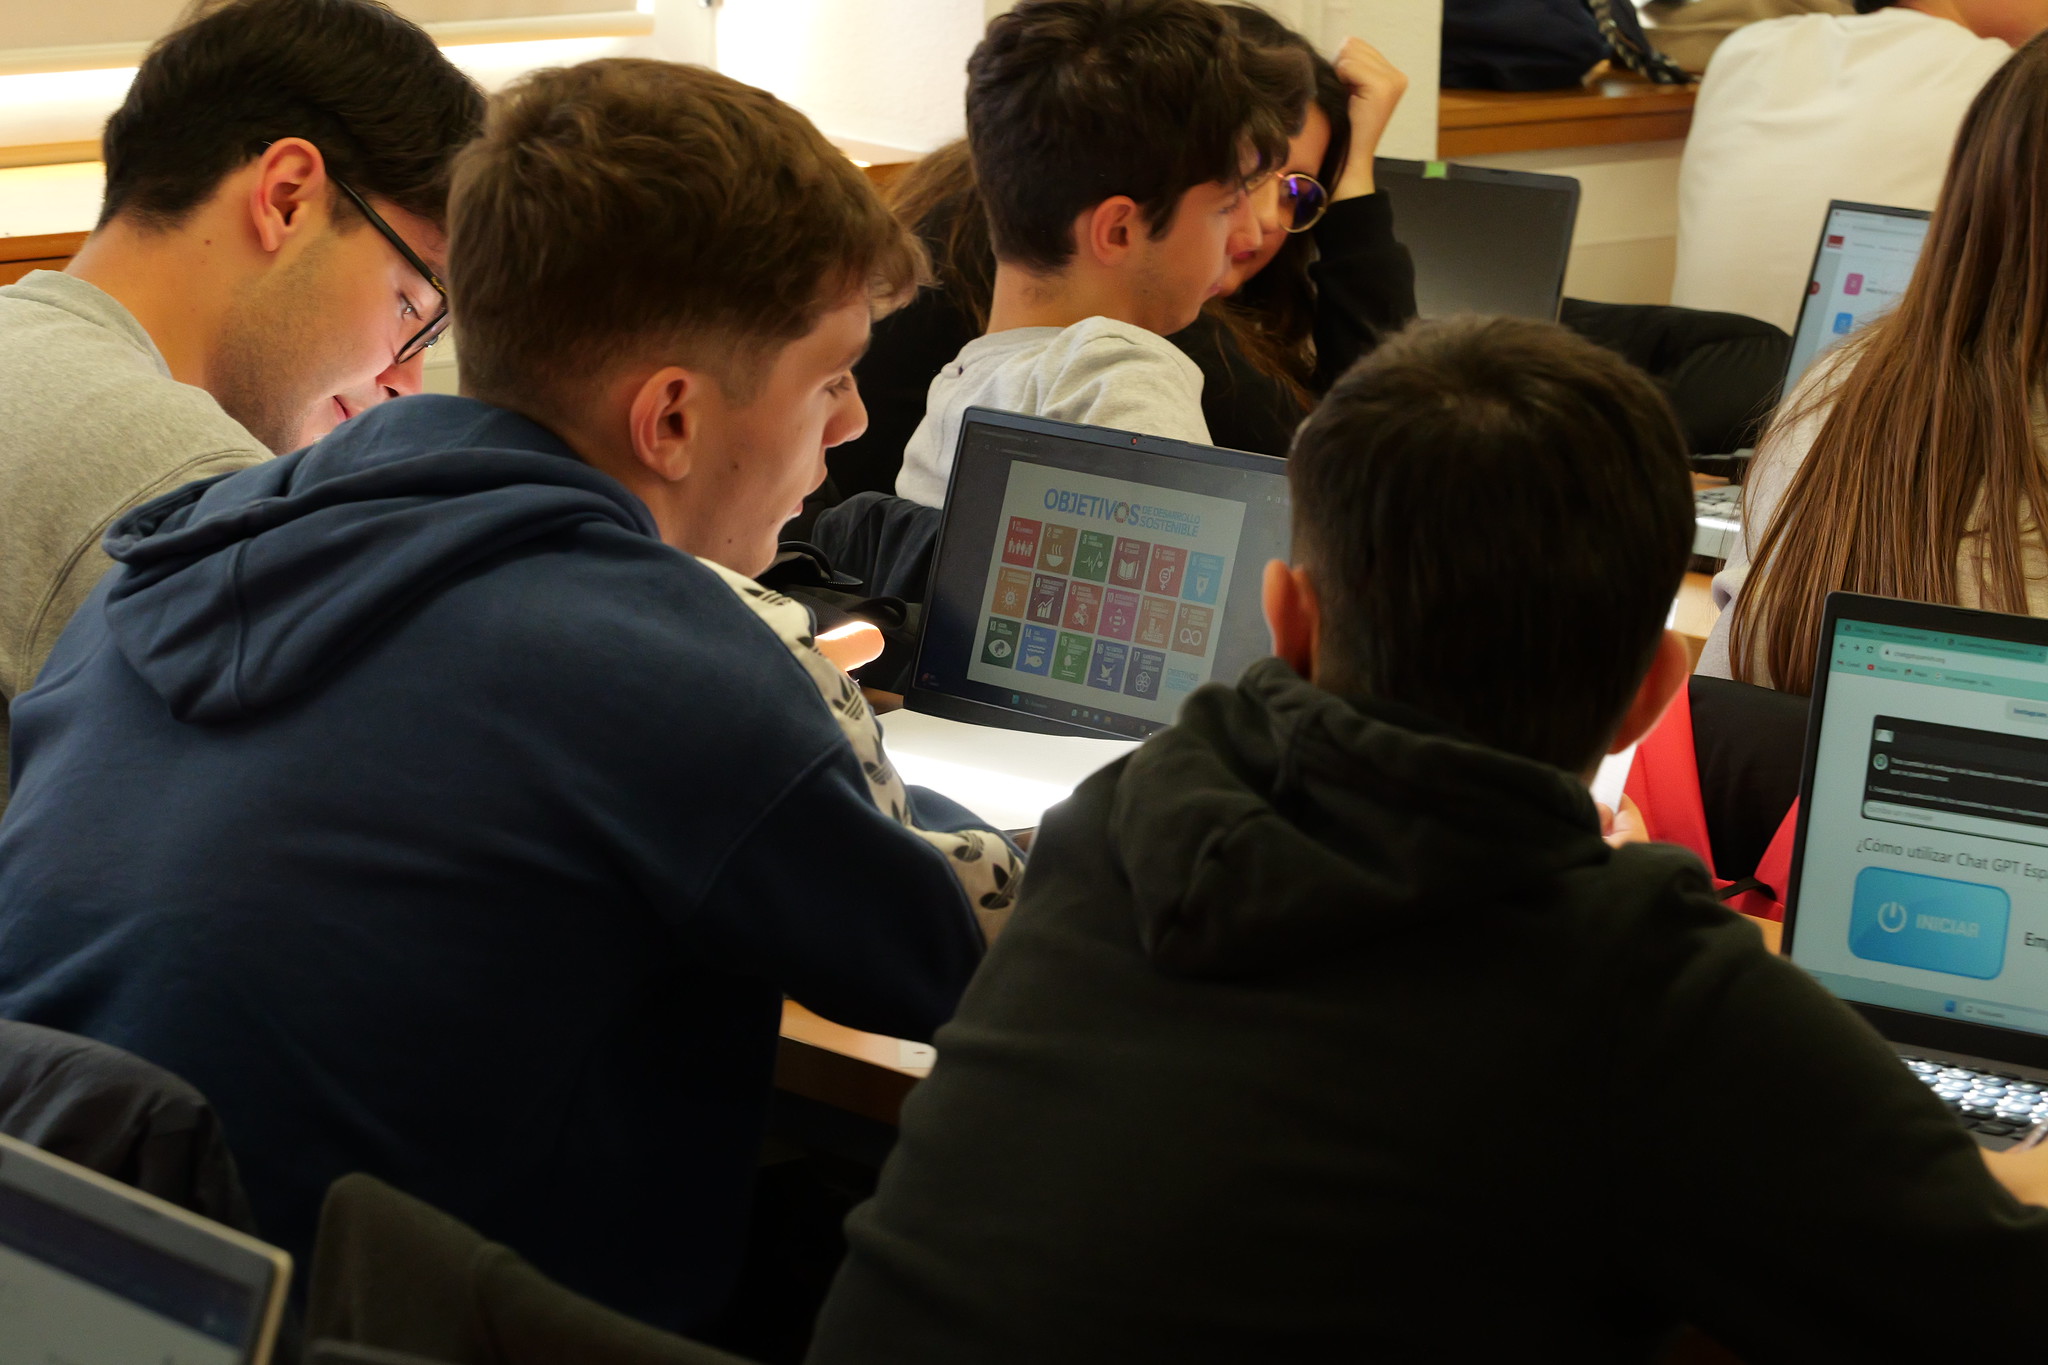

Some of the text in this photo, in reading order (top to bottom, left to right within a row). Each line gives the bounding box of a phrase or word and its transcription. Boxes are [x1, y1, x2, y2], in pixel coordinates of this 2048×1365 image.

[1044, 488, 1141, 526] OBJETIVOS
[1139, 516, 1200, 537] SOSTENIBLE
[1106, 592, 1114, 603] 10
[1856, 837, 1903, 856] ¿Cómo
[1907, 845, 1953, 863] utilizar
[1956, 852, 1988, 869] Chat
[1992, 858, 2021, 874] GPT
[1916, 914, 1980, 938] INICIAR
[2024, 931, 2048, 952] Em
